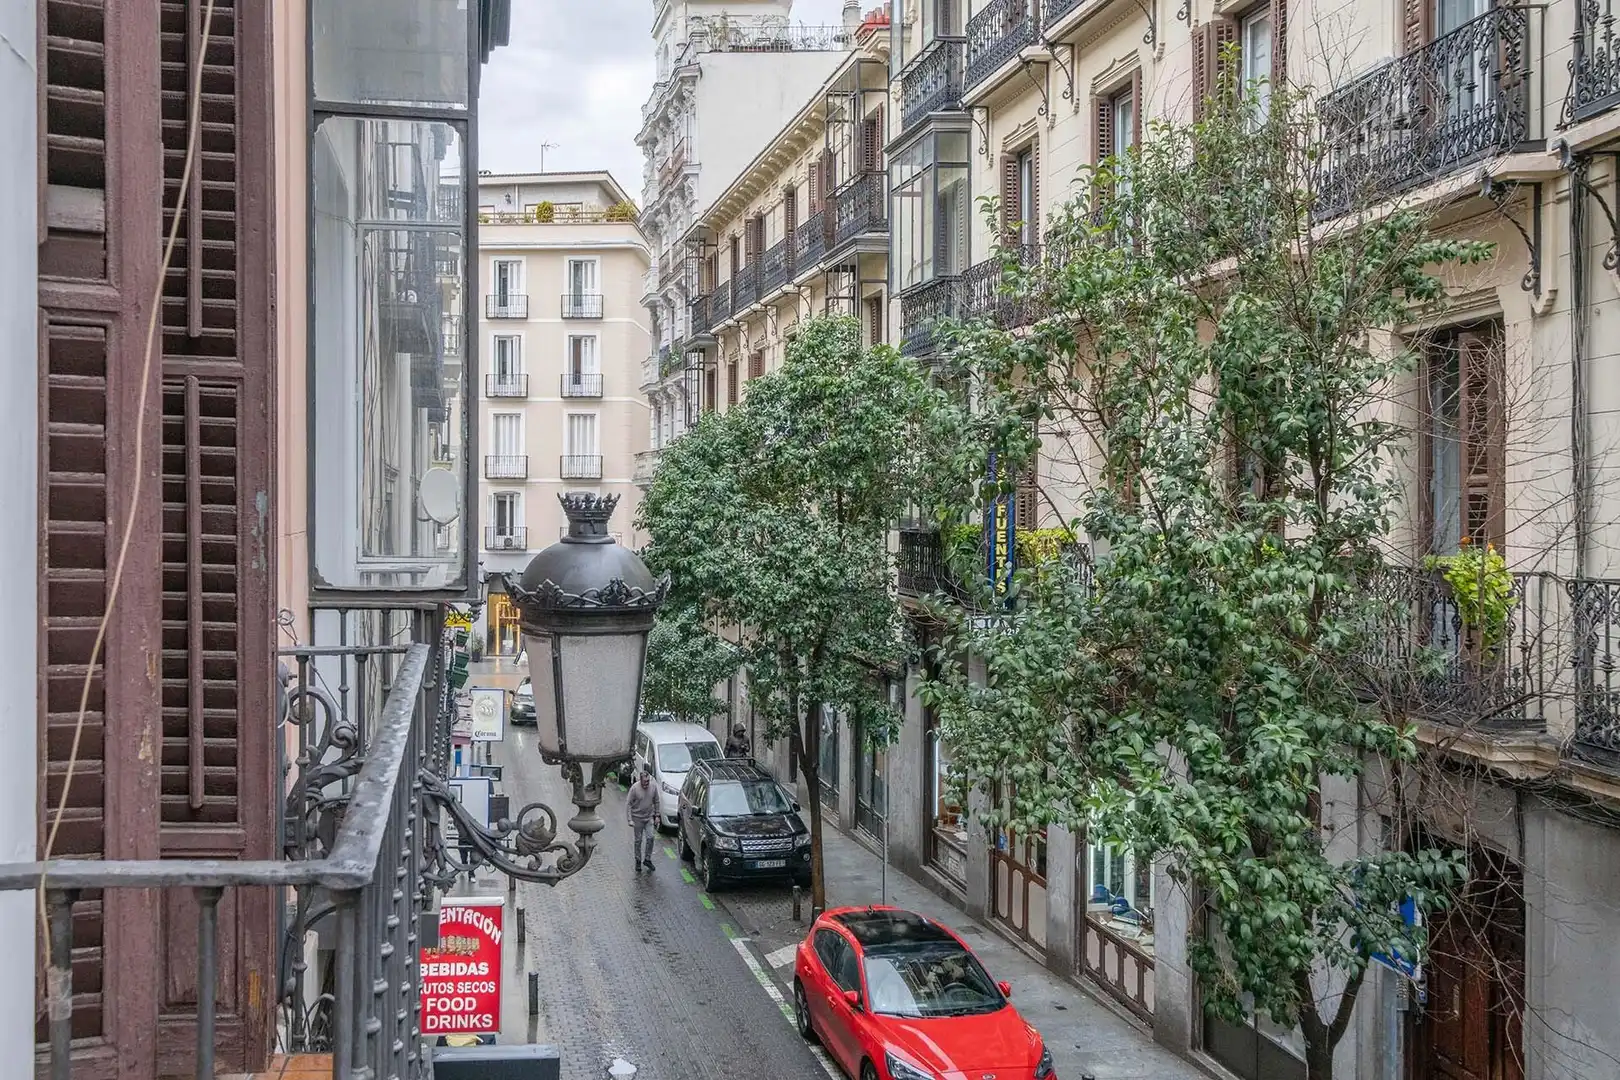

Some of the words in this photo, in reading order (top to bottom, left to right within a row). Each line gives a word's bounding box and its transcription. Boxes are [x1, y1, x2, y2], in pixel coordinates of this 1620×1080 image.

[420, 962, 489, 976] BEBIDAS
[420, 982, 454, 995] UTOS
[456, 981, 496, 994] SECOS
[426, 997, 477, 1012] FOOD
[426, 1014, 493, 1029] DRINKS
